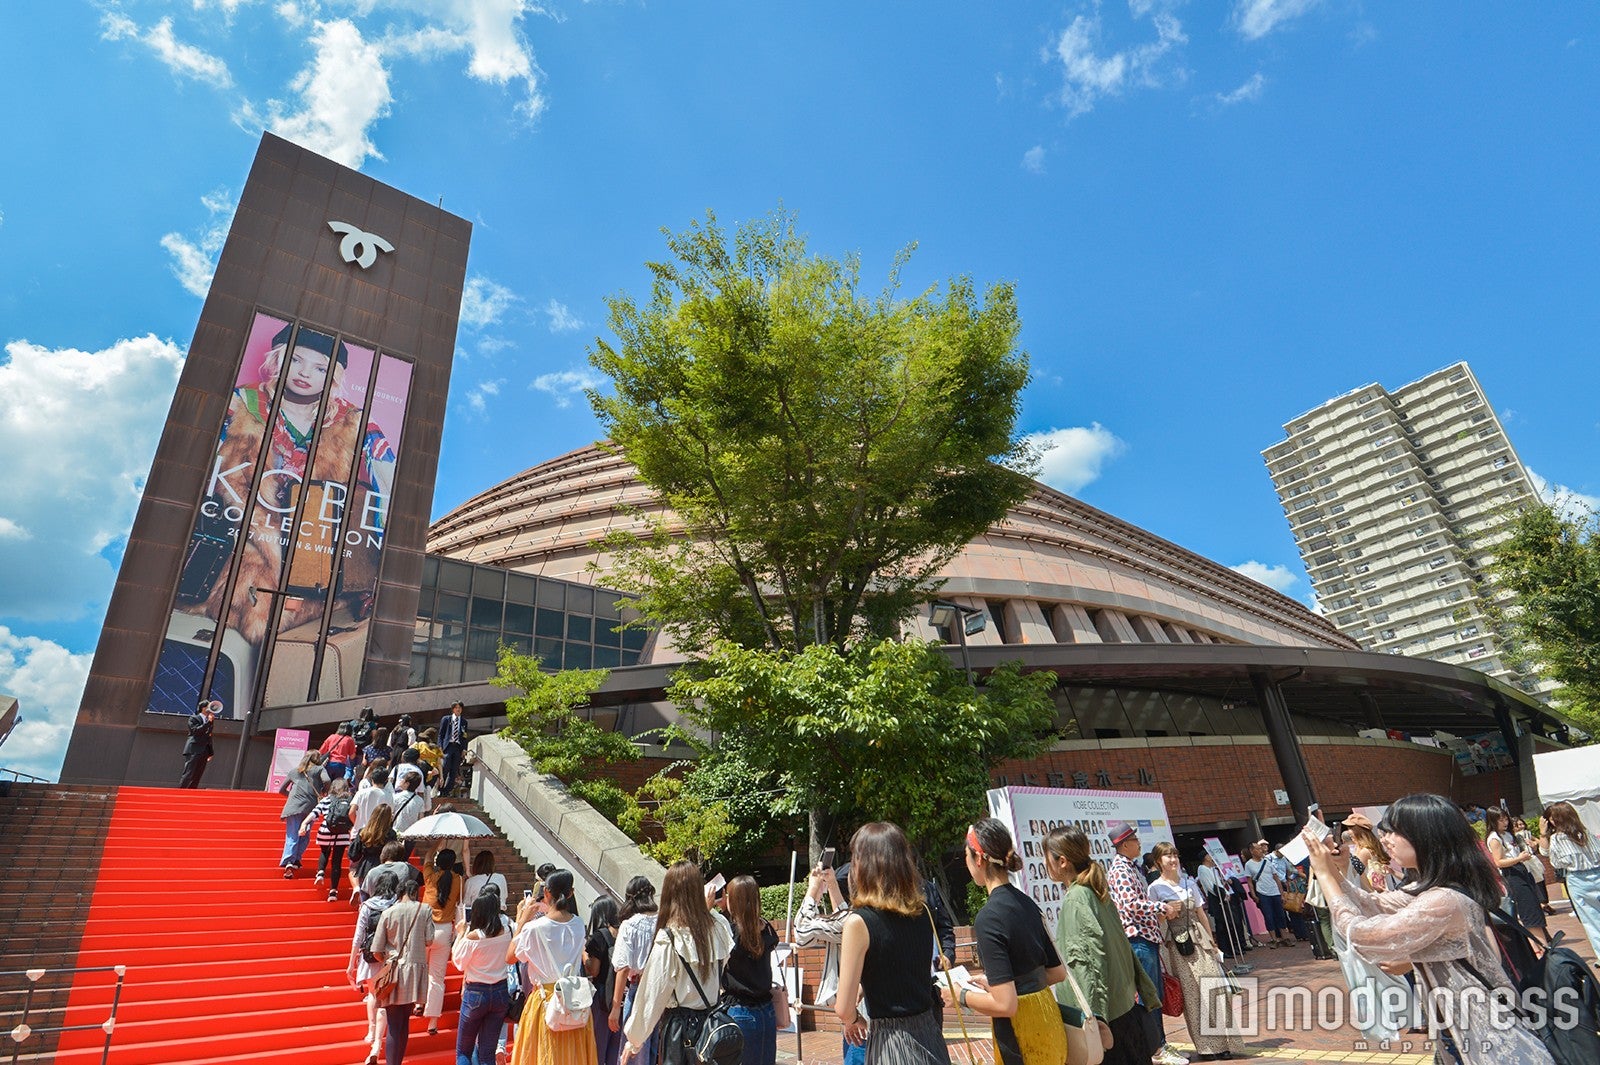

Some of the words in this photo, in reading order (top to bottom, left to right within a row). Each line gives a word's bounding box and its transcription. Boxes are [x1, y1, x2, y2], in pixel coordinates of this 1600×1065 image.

[206, 455, 391, 533] KOBE
[200, 501, 383, 550] COLLECTION
[227, 527, 254, 540] 207
[258, 531, 302, 547] AUTUN
[304, 542, 312, 551] &
[314, 544, 353, 559] WINER
[1072, 800, 1087, 810] KOBE
[1087, 800, 1119, 810] COLLECTION
